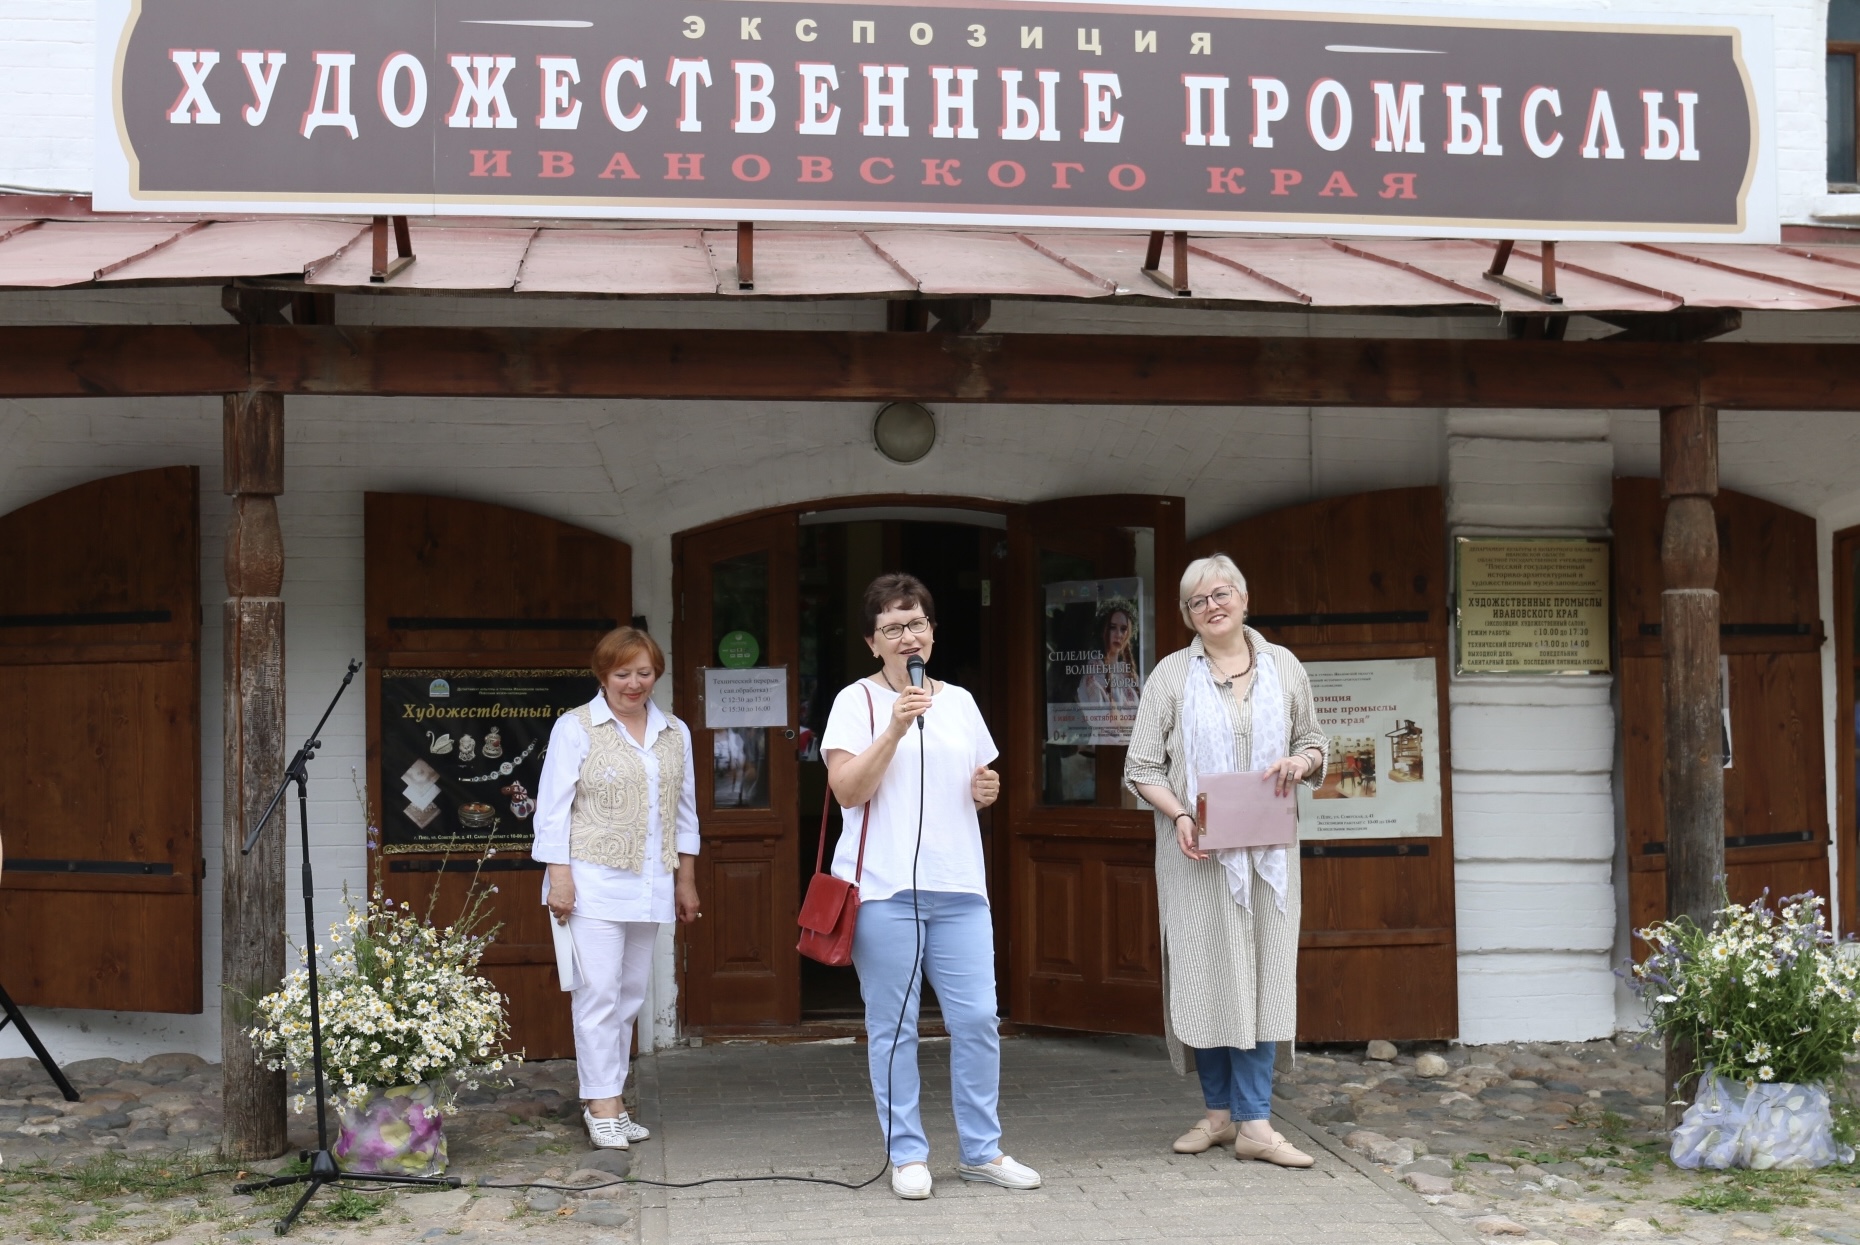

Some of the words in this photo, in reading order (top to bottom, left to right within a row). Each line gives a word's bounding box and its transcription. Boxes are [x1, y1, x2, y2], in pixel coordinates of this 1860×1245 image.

[682, 14, 1212, 56] ЭКСПОЗИЦИЯ
[168, 48, 1124, 143] ХУДОЖЕСТВЕННЫЕ
[1181, 73, 1700, 161] ПРОМЫСЛЫ
[470, 150, 1147, 191] ИВАНОВСКОГО
[1207, 167, 1416, 200] КРАЯ
[1524, 563, 1586, 572] государственный
[1487, 571, 1577, 580] историко-архитектурный
[1472, 579, 1532, 588] художественный
[1468, 597, 1551, 608] ХУДОЖЕСТВЕННЫЕ
[1554, 597, 1603, 608] ПРОМЫСЛЫ
[1492, 609, 1553, 619] ИВАНОВСКОГО
[1556, 609, 1578, 618] КРАЯ
[1048, 649, 1104, 662] СПЛЕЛИСЬ
[1065, 663, 1132, 675] ВОЛШЕБНЫЕ
[753, 678, 779, 686] перерыв
[1313, 695, 1351, 703] озиция
[402, 703, 551, 723] Художественный
[1341, 705, 1397, 716] промыслы
[1090, 713, 1118, 723] октября
[1053, 730, 1067, 741] 0+
